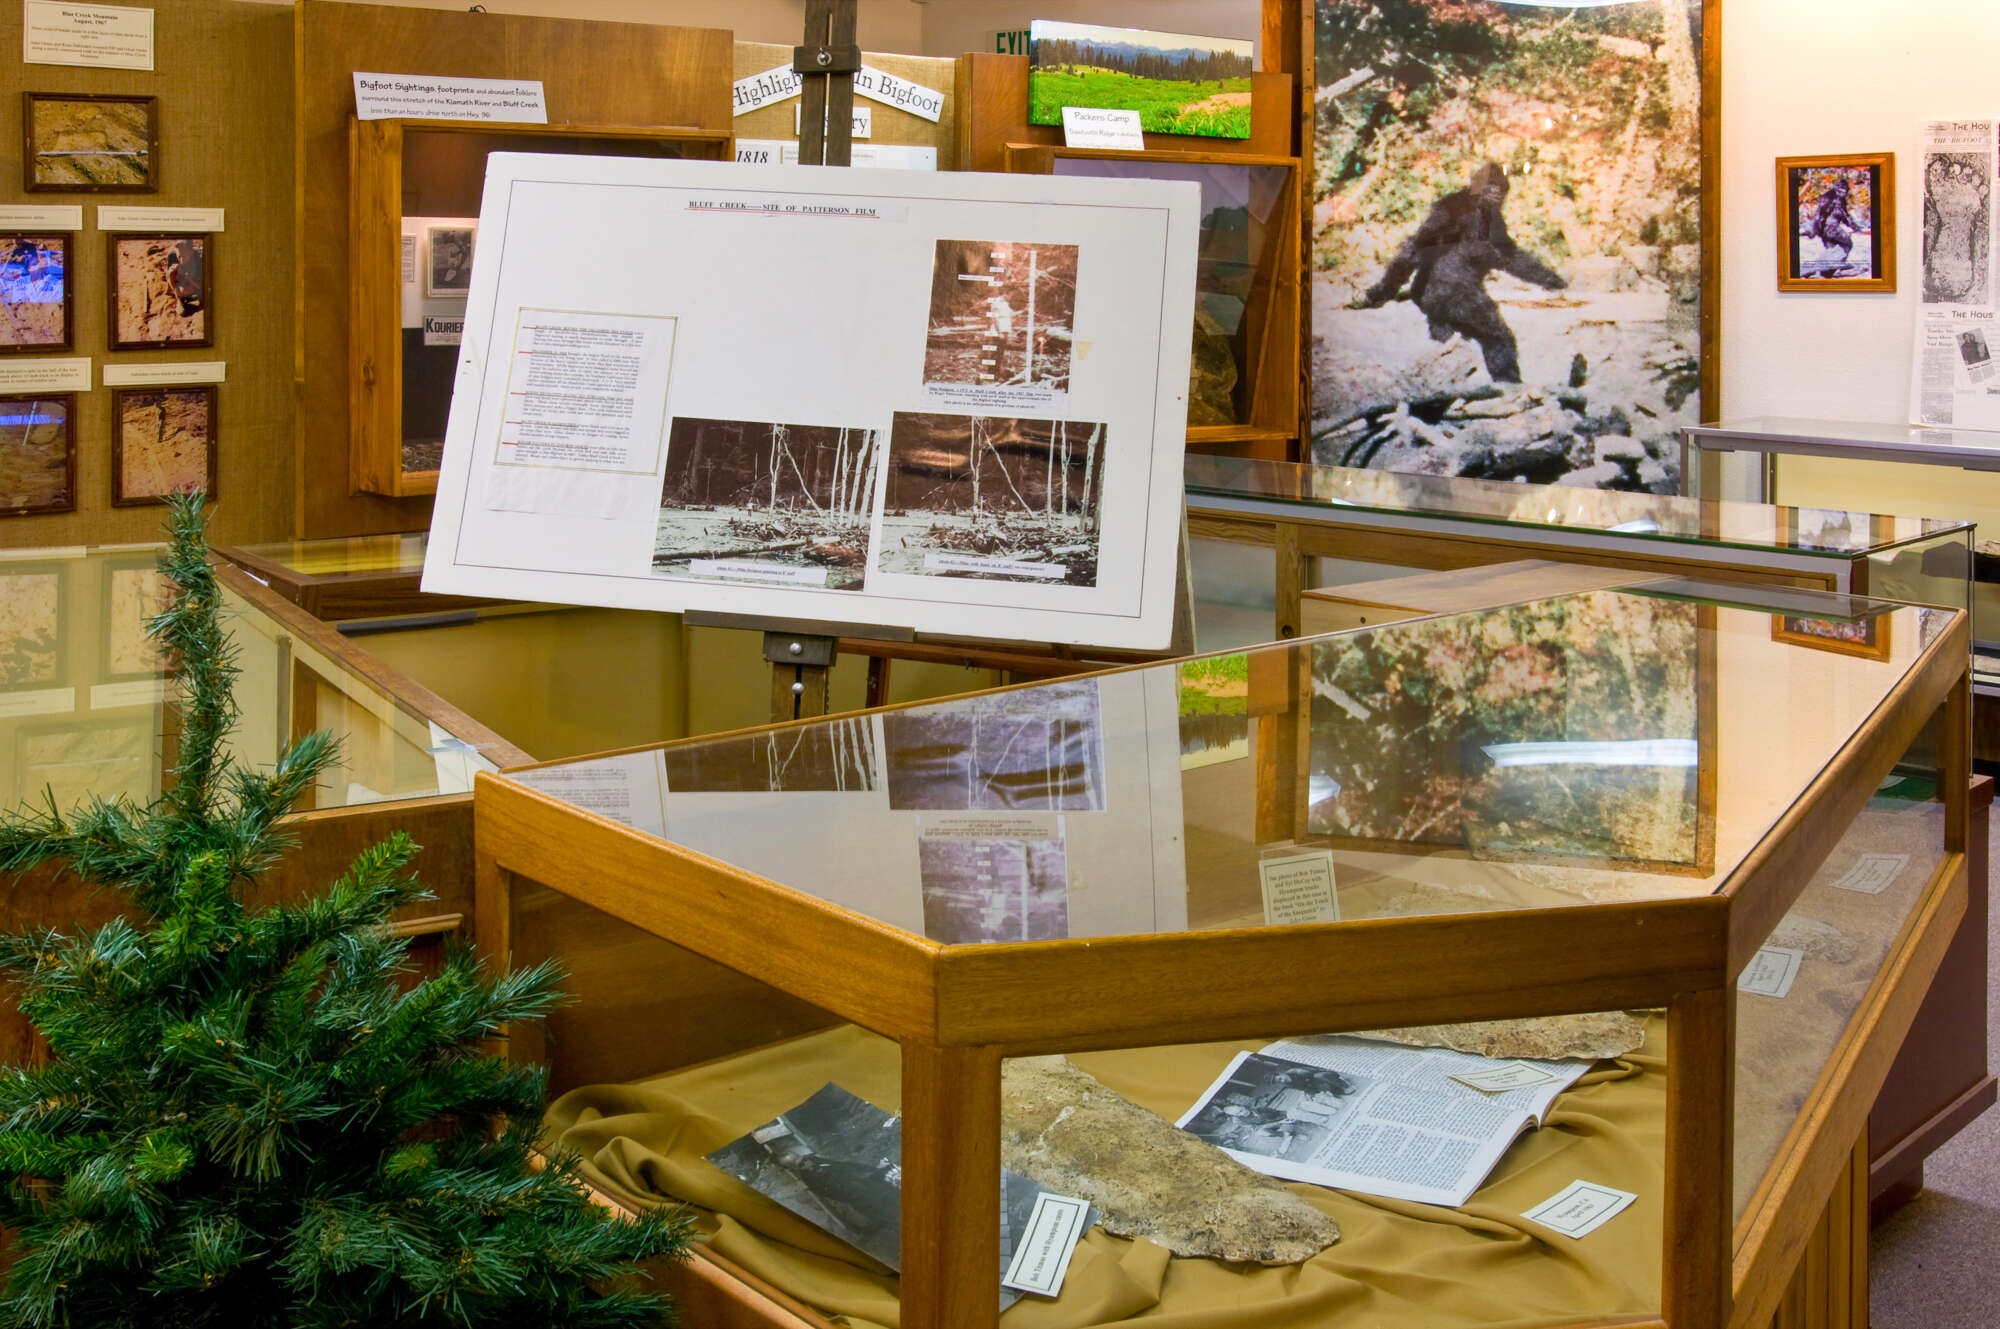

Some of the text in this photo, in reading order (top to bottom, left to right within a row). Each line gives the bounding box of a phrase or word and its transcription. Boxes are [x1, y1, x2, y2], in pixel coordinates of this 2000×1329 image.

[360, 80, 392, 90] Bigfoot
[437, 84, 475, 96] footprints
[854, 69, 940, 115] In Bigfoot
[1107, 113, 1130, 125] Camp
[1952, 123, 1968, 131] THE
[736, 150, 769, 164] 1818
[802, 206, 850, 214] PATTERSON
[855, 208, 876, 216] FILM
[1952, 310, 1967, 318] THE
